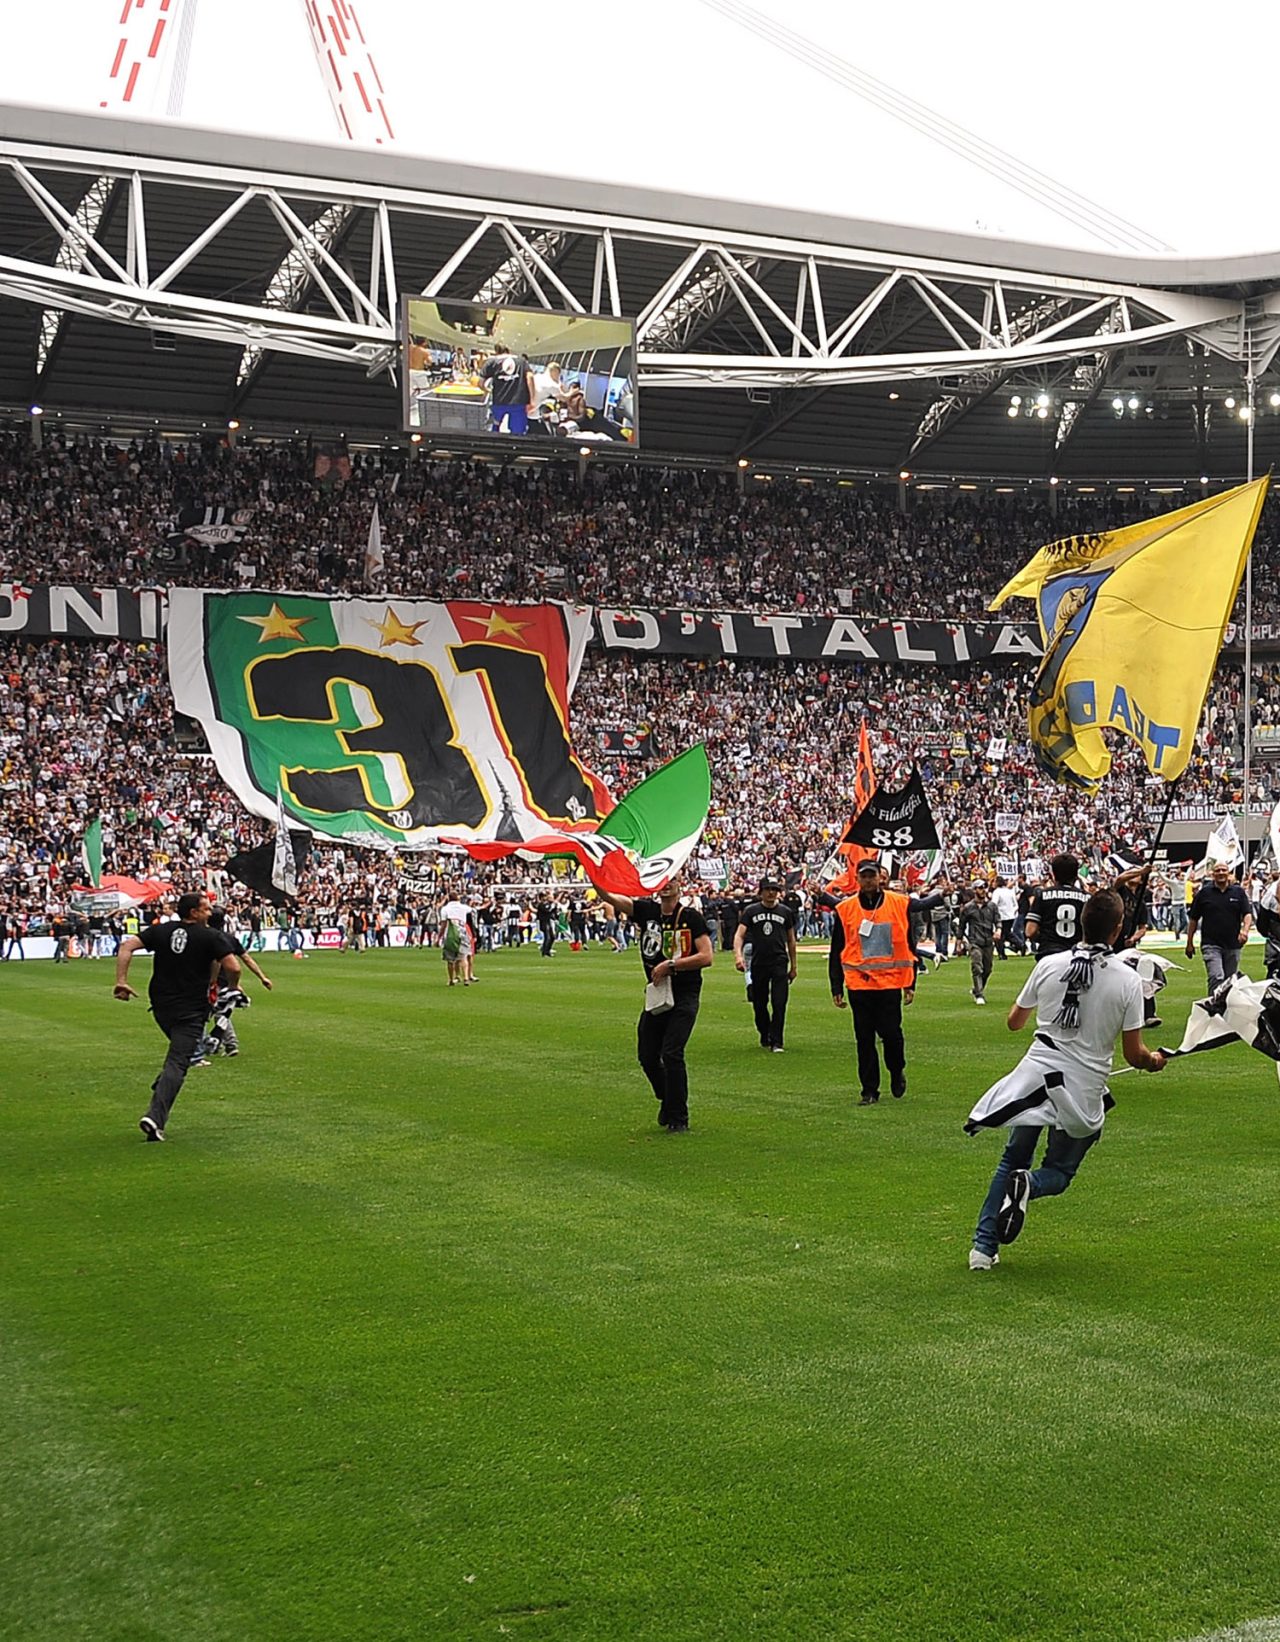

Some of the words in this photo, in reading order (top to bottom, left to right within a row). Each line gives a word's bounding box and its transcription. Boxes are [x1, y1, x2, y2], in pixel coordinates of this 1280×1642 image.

[600, 608, 1044, 662] D'ITALIA
[244, 640, 609, 831] 31
[871, 826, 914, 847] 88
[397, 877, 435, 894] PAZZI
[1055, 903, 1077, 939] 8
